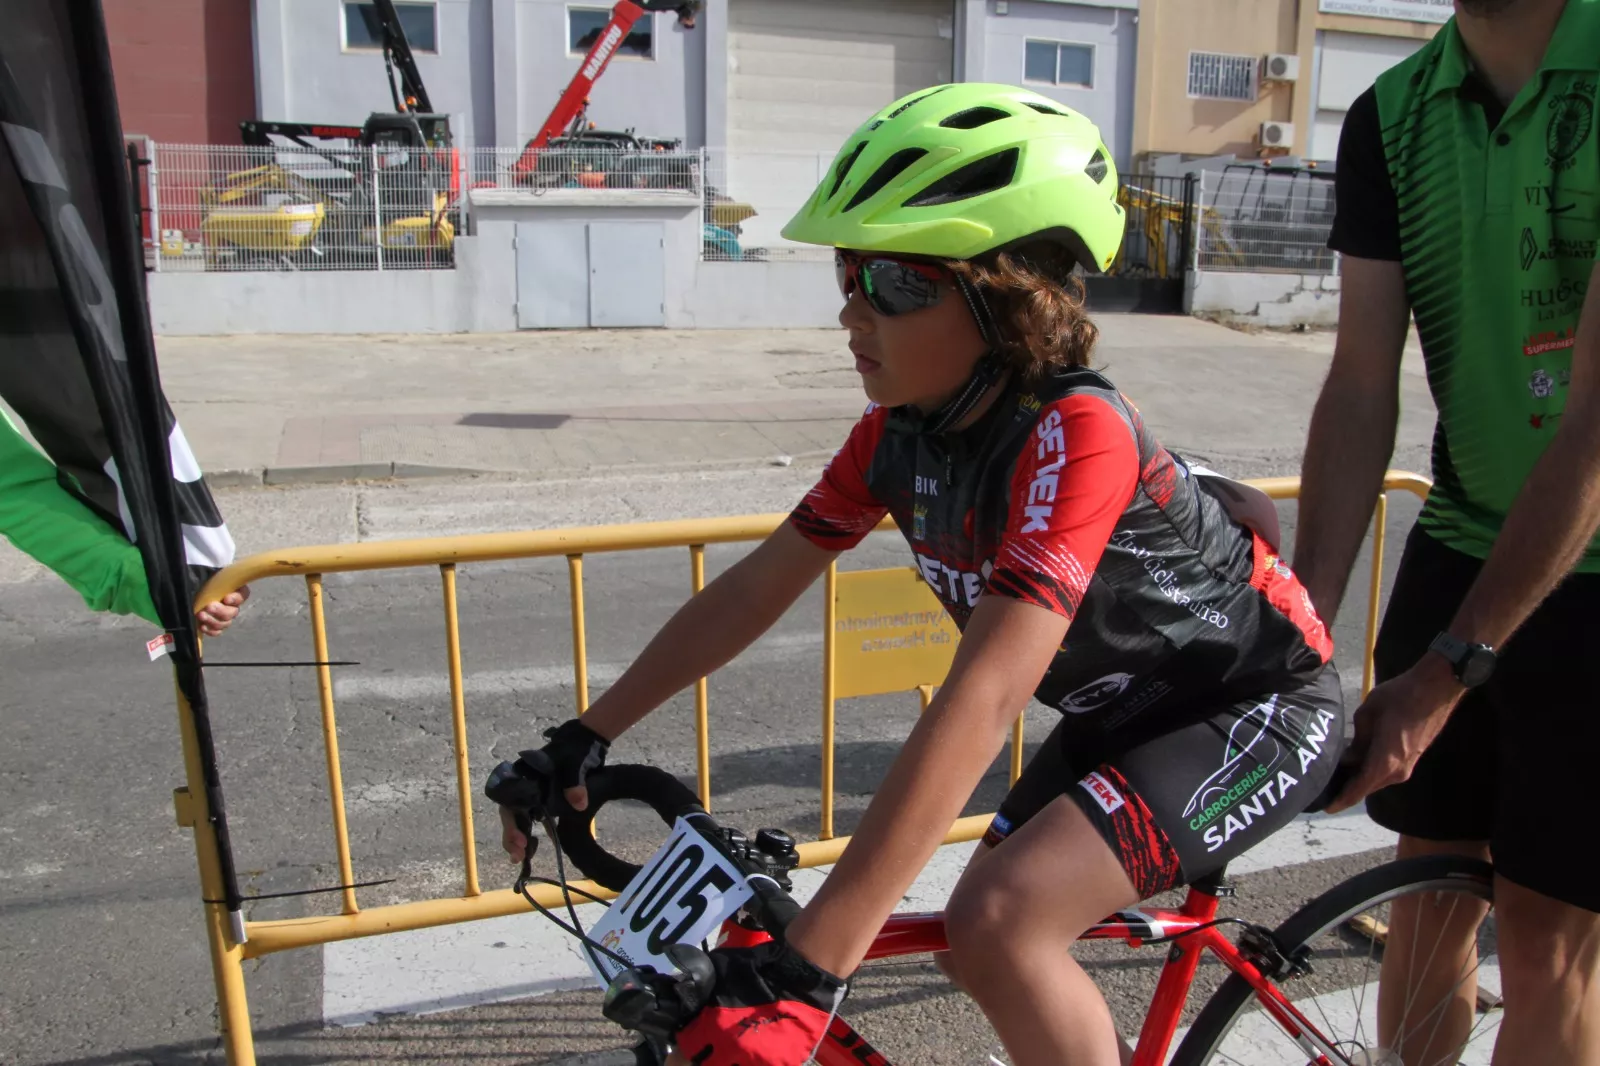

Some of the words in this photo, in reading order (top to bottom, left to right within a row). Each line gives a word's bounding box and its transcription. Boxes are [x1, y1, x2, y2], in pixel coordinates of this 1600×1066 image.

[583, 24, 622, 80] MANITOU
[1021, 409, 1066, 533] SETEK
[914, 552, 993, 608] ETE
[1189, 763, 1268, 831] CARROCERÍAS
[1203, 770, 1299, 853] SANTA
[1297, 708, 1335, 776] ANA
[620, 831, 737, 956] 105
